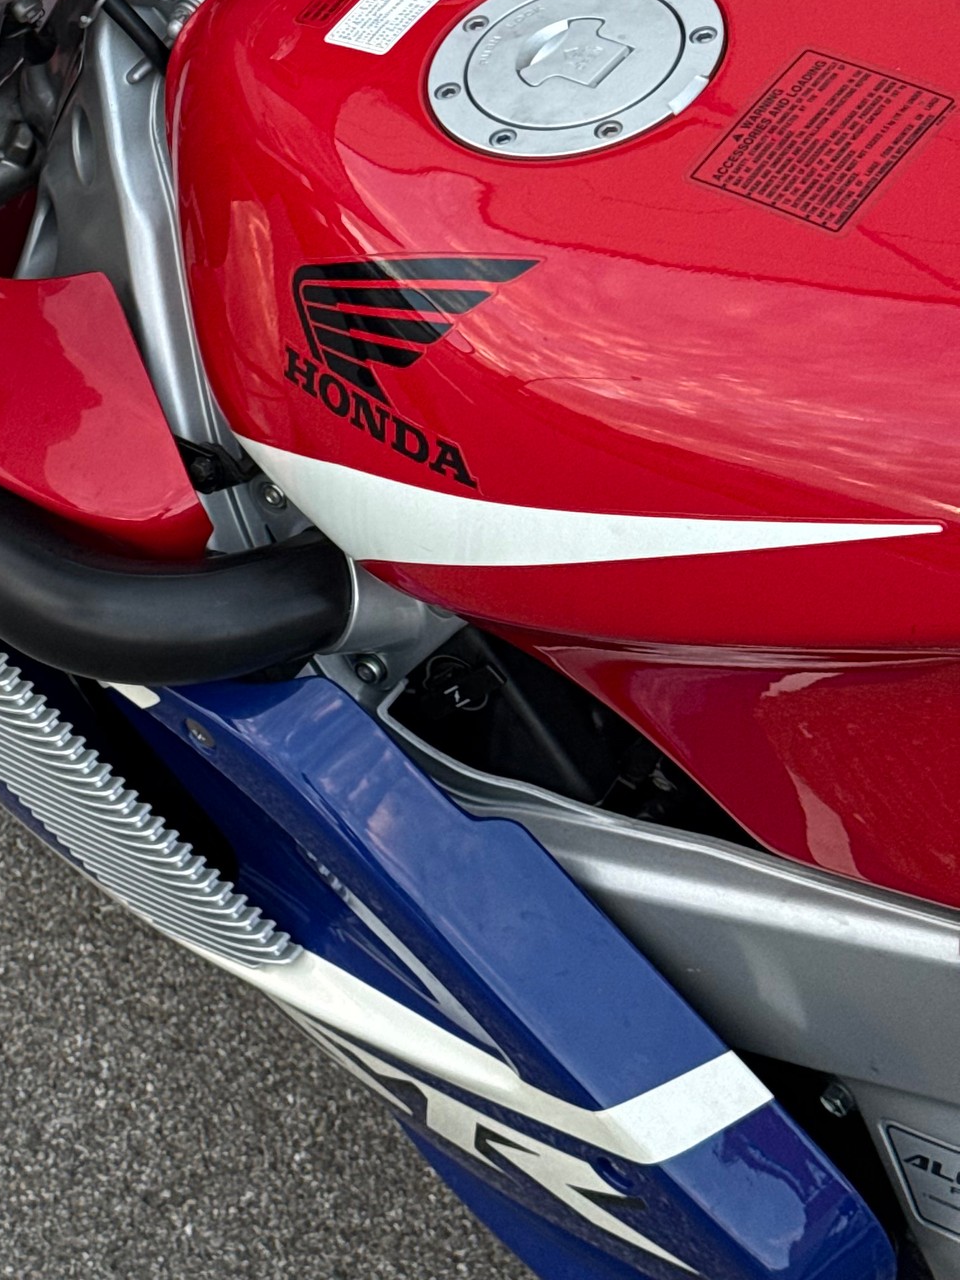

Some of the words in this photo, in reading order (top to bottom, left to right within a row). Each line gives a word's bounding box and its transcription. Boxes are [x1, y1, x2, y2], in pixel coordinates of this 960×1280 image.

[712, 117, 772, 181] ACCESSORIES
[768, 98, 790, 118] AND
[786, 60, 827, 97] LOADING
[740, 88, 784, 129] WARNING
[283, 346, 477, 489] HONDA
[903, 1154, 960, 1185] AL
